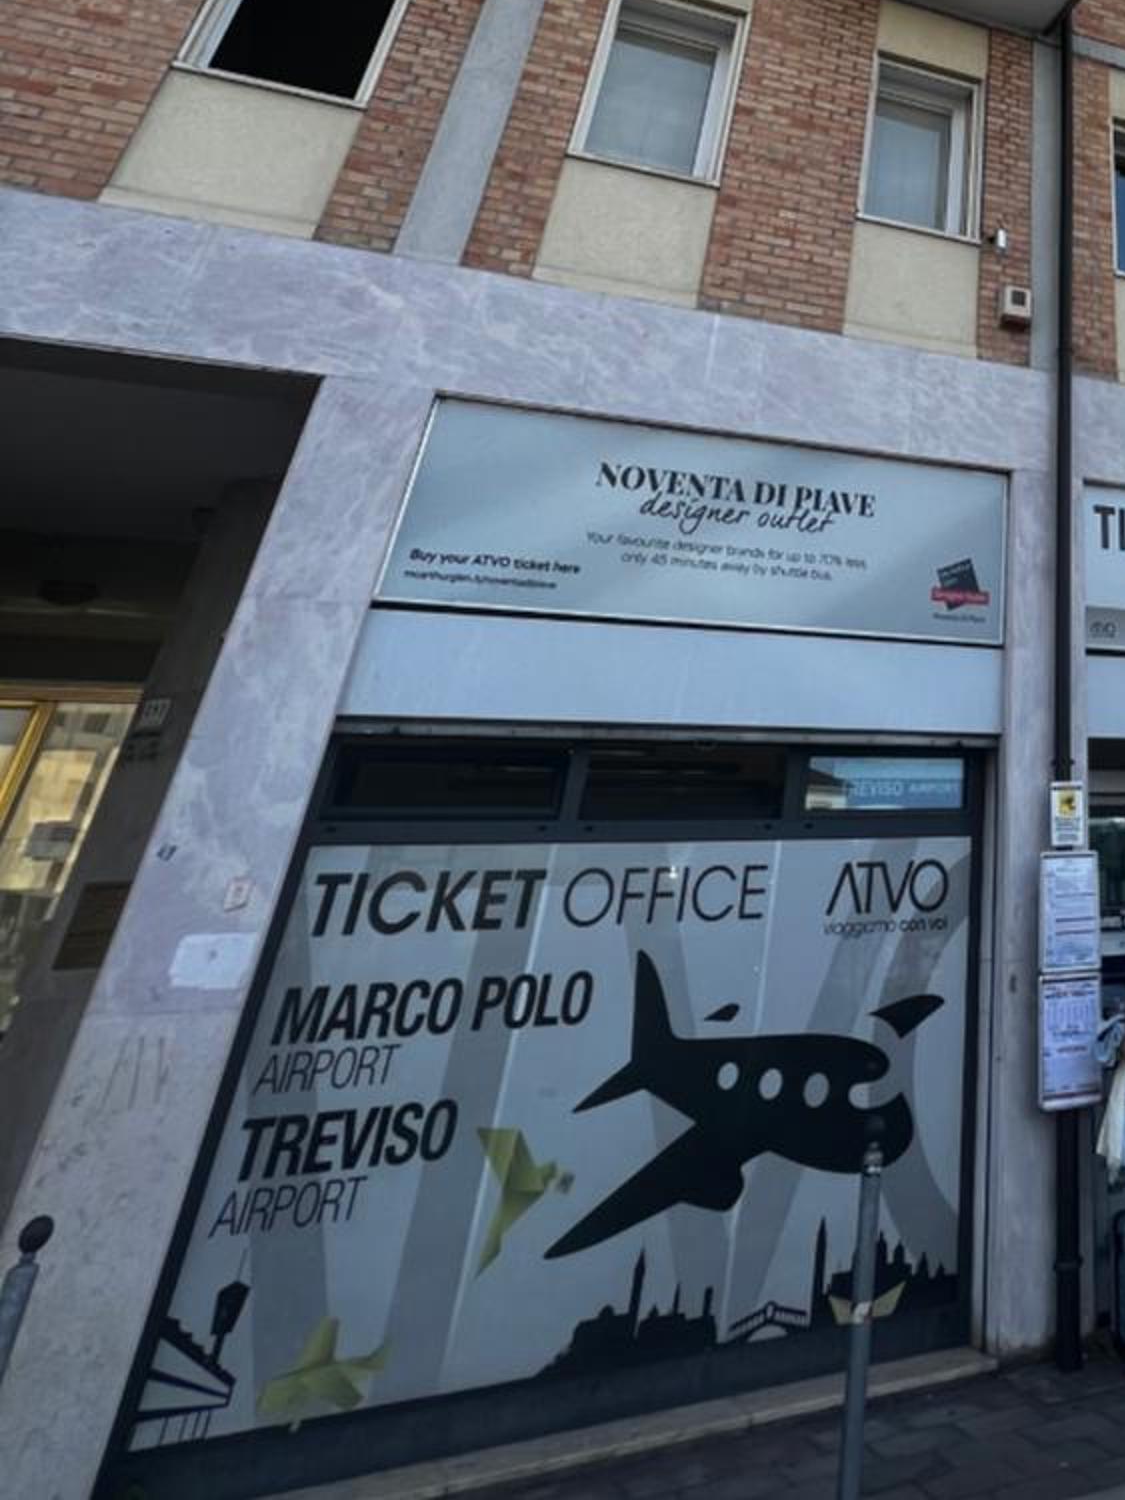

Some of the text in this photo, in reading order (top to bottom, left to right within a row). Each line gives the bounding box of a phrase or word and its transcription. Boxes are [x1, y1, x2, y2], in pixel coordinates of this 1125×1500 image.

[596, 461, 876, 518] NOVENTA DI PIAVE
[639, 490, 835, 535] designer outlet
[409, 548, 580, 574] Buy your ATVO ticket here
[586, 531, 614, 545] Your
[617, 534, 670, 550] favourite
[672, 540, 723, 555] designer
[726, 545, 765, 559] brands
[767, 548, 784, 560] for
[621, 551, 648, 566] only
[650, 553, 668, 565] 45
[670, 556, 718, 571] minutes
[720, 562, 750, 575] away
[752, 563, 768, 576] by
[770, 565, 808, 578] shuttle
[312, 862, 769, 937] TICKET OFFICE
[825, 859, 949, 916] ATVO
[899, 916, 926, 932] con
[927, 915, 948, 931] voi
[271, 970, 594, 1046] MARCO POLO
[252, 1043, 402, 1096] AIRPORT
[238, 1099, 459, 1182] TREVISO
[208, 1175, 368, 1238] AIRPORT
